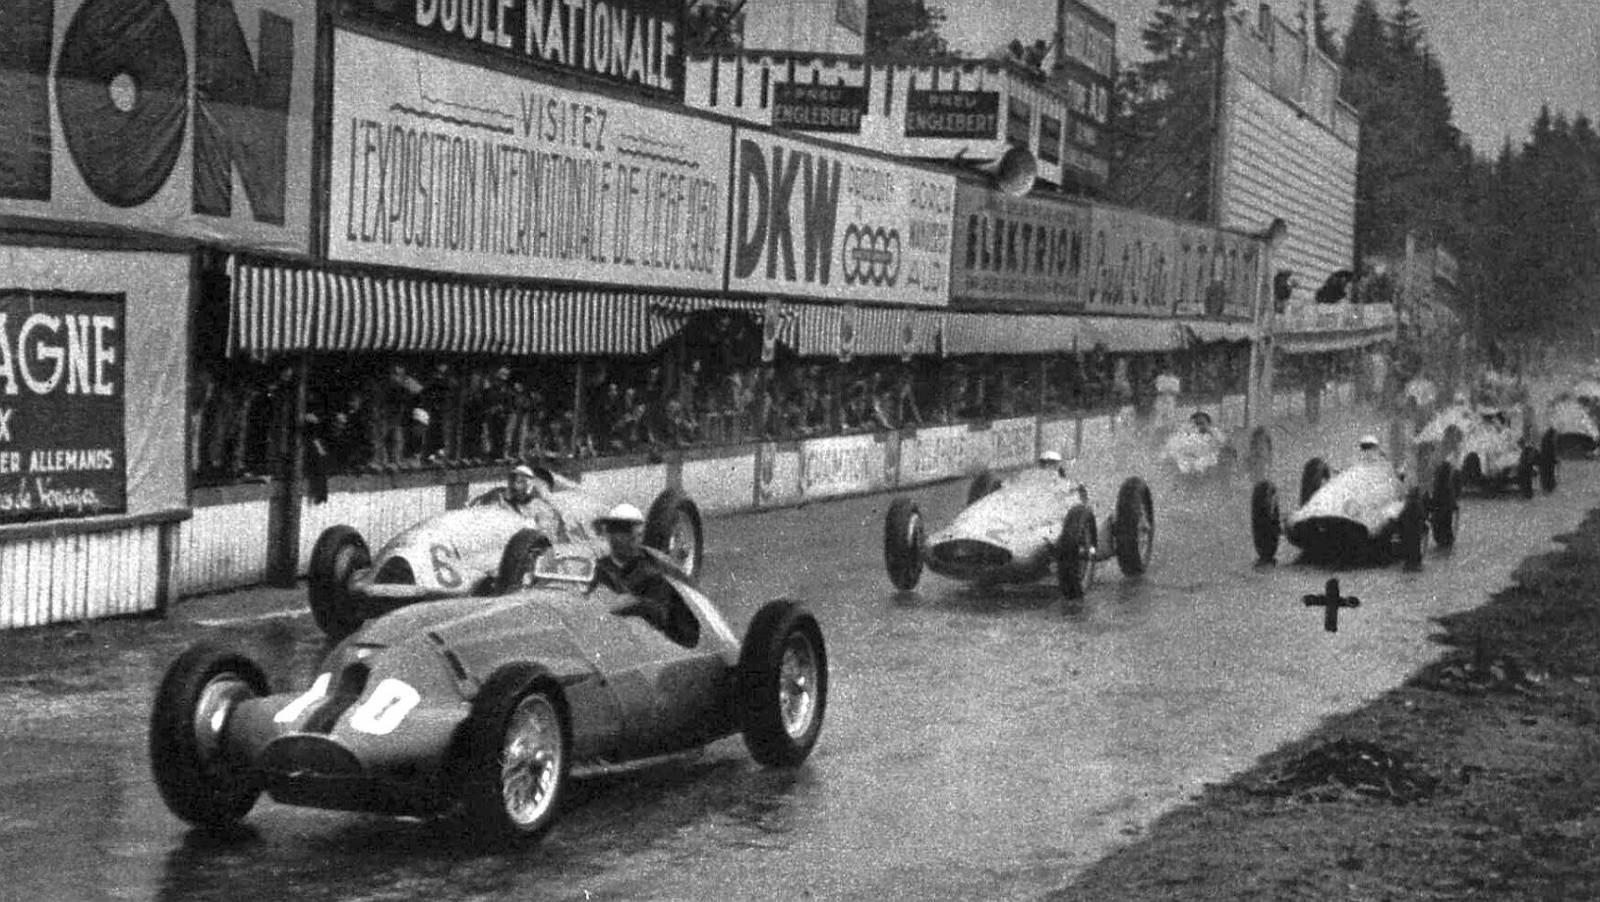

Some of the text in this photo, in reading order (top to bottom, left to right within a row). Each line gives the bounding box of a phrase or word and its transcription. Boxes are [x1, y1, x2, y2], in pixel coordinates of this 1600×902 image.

[525, 0, 676, 91] NATIONALE
[520, 91, 608, 152] VISITEZ
[774, 103, 860, 127] ENGLEBERT
[906, 111, 997, 132] ENGLEBERT
[613, 164, 641, 266] DE
[734, 138, 842, 286] DKW
[0, 448, 114, 474] ER ALLEMANDS
[430, 543, 463, 589] 6
[273, 671, 421, 736] 10
